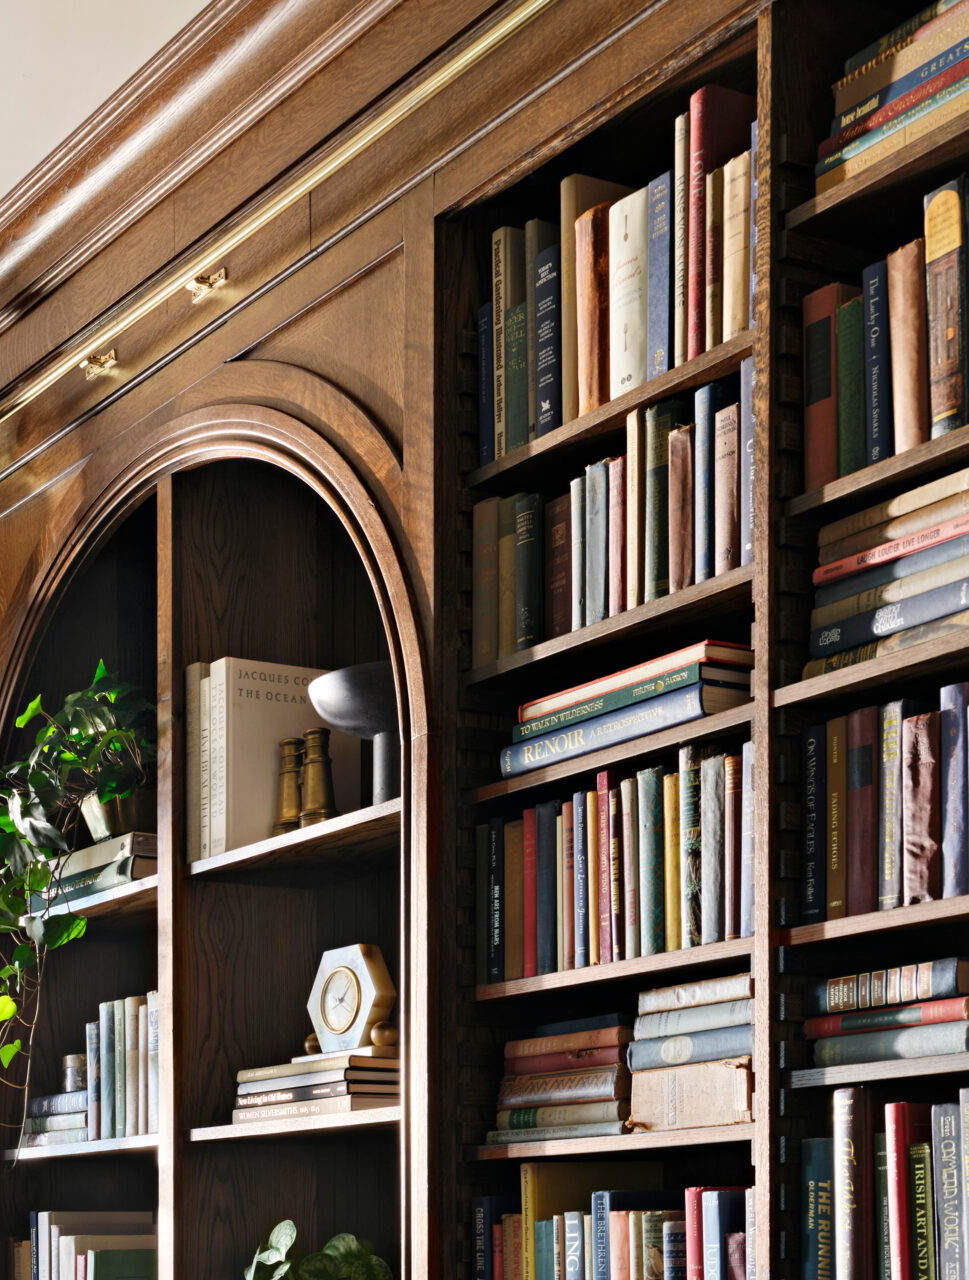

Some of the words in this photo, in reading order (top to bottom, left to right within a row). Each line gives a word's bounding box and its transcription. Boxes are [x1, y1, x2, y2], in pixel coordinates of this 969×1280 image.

[691, 149, 705, 204] LOVE
[494, 240, 503, 278] Practical
[494, 280, 503, 325] Gardening
[868, 275, 880, 295] The
[868, 297, 880, 325] Lucky
[494, 328, 503, 371] Illustrated
[868, 327, 880, 348] One
[494, 374, 503, 397] Arthur
[871, 365, 880, 407] NICHOLAS
[494, 399, 503, 424] Hellyer
[871, 408, 880, 438] SPARKS
[856, 551, 877, 566] LAUGH
[877, 543, 899, 558] LOUDER
[902, 538, 915, 550] LIVE
[917, 529, 940, 546] LONGER
[238, 669, 289, 684] JACQUES
[217, 682, 225, 743] JACQUES
[238, 687, 261, 700] THE
[265, 692, 309, 705] OCEAN
[520, 725, 531, 736] TO
[531, 719, 550, 732] WALK
[550, 717, 557, 726] IN
[557, 699, 604, 723] WILDERNESS
[523, 728, 586, 764] RENOIR
[590, 730, 596, 738] A
[596, 706, 664, 736] RETROSPECTIVE
[807, 738, 817, 755] ON
[883, 717, 898, 763] KERR
[217, 745, 225, 816] COUSTEAU
[807, 756, 817, 794] WINGS
[807, 795, 817, 810] OF
[831, 792, 839, 829] FADING
[807, 813, 817, 855] EAGLES
[831, 830, 839, 871] ECHOES
[807, 861, 817, 878] Ken
[807, 879, 817, 903] Follett
[239, 1110, 259, 1120] WOMEN
[259, 1107, 298, 1118] SILVERSMITHS
[246, 1095, 262, 1106] Living
[943, 1115, 952, 1137] Green
[840, 1138, 857, 1177] The
[940, 1139, 957, 1199] CAMERA
[816, 1180, 831, 1217] THE
[914, 1163, 926, 1205] IRISH
[475, 1207, 485, 1234] CROSS
[597, 1199, 607, 1218] THE
[808, 1180, 816, 1230] OLDERMAN
[840, 1179, 857, 1233] West
[915, 1207, 927, 1235] ART
[475, 1235, 485, 1252] THE
[513, 1218, 523, 1239] The
[943, 1201, 958, 1249] WORK
[475, 1252, 485, 1271] LINE
[513, 1241, 523, 1278] Secret
[566, 1218, 580, 1272] LING
[597, 1220, 607, 1272] BRETHREN
[916, 1237, 928, 1269] AND
